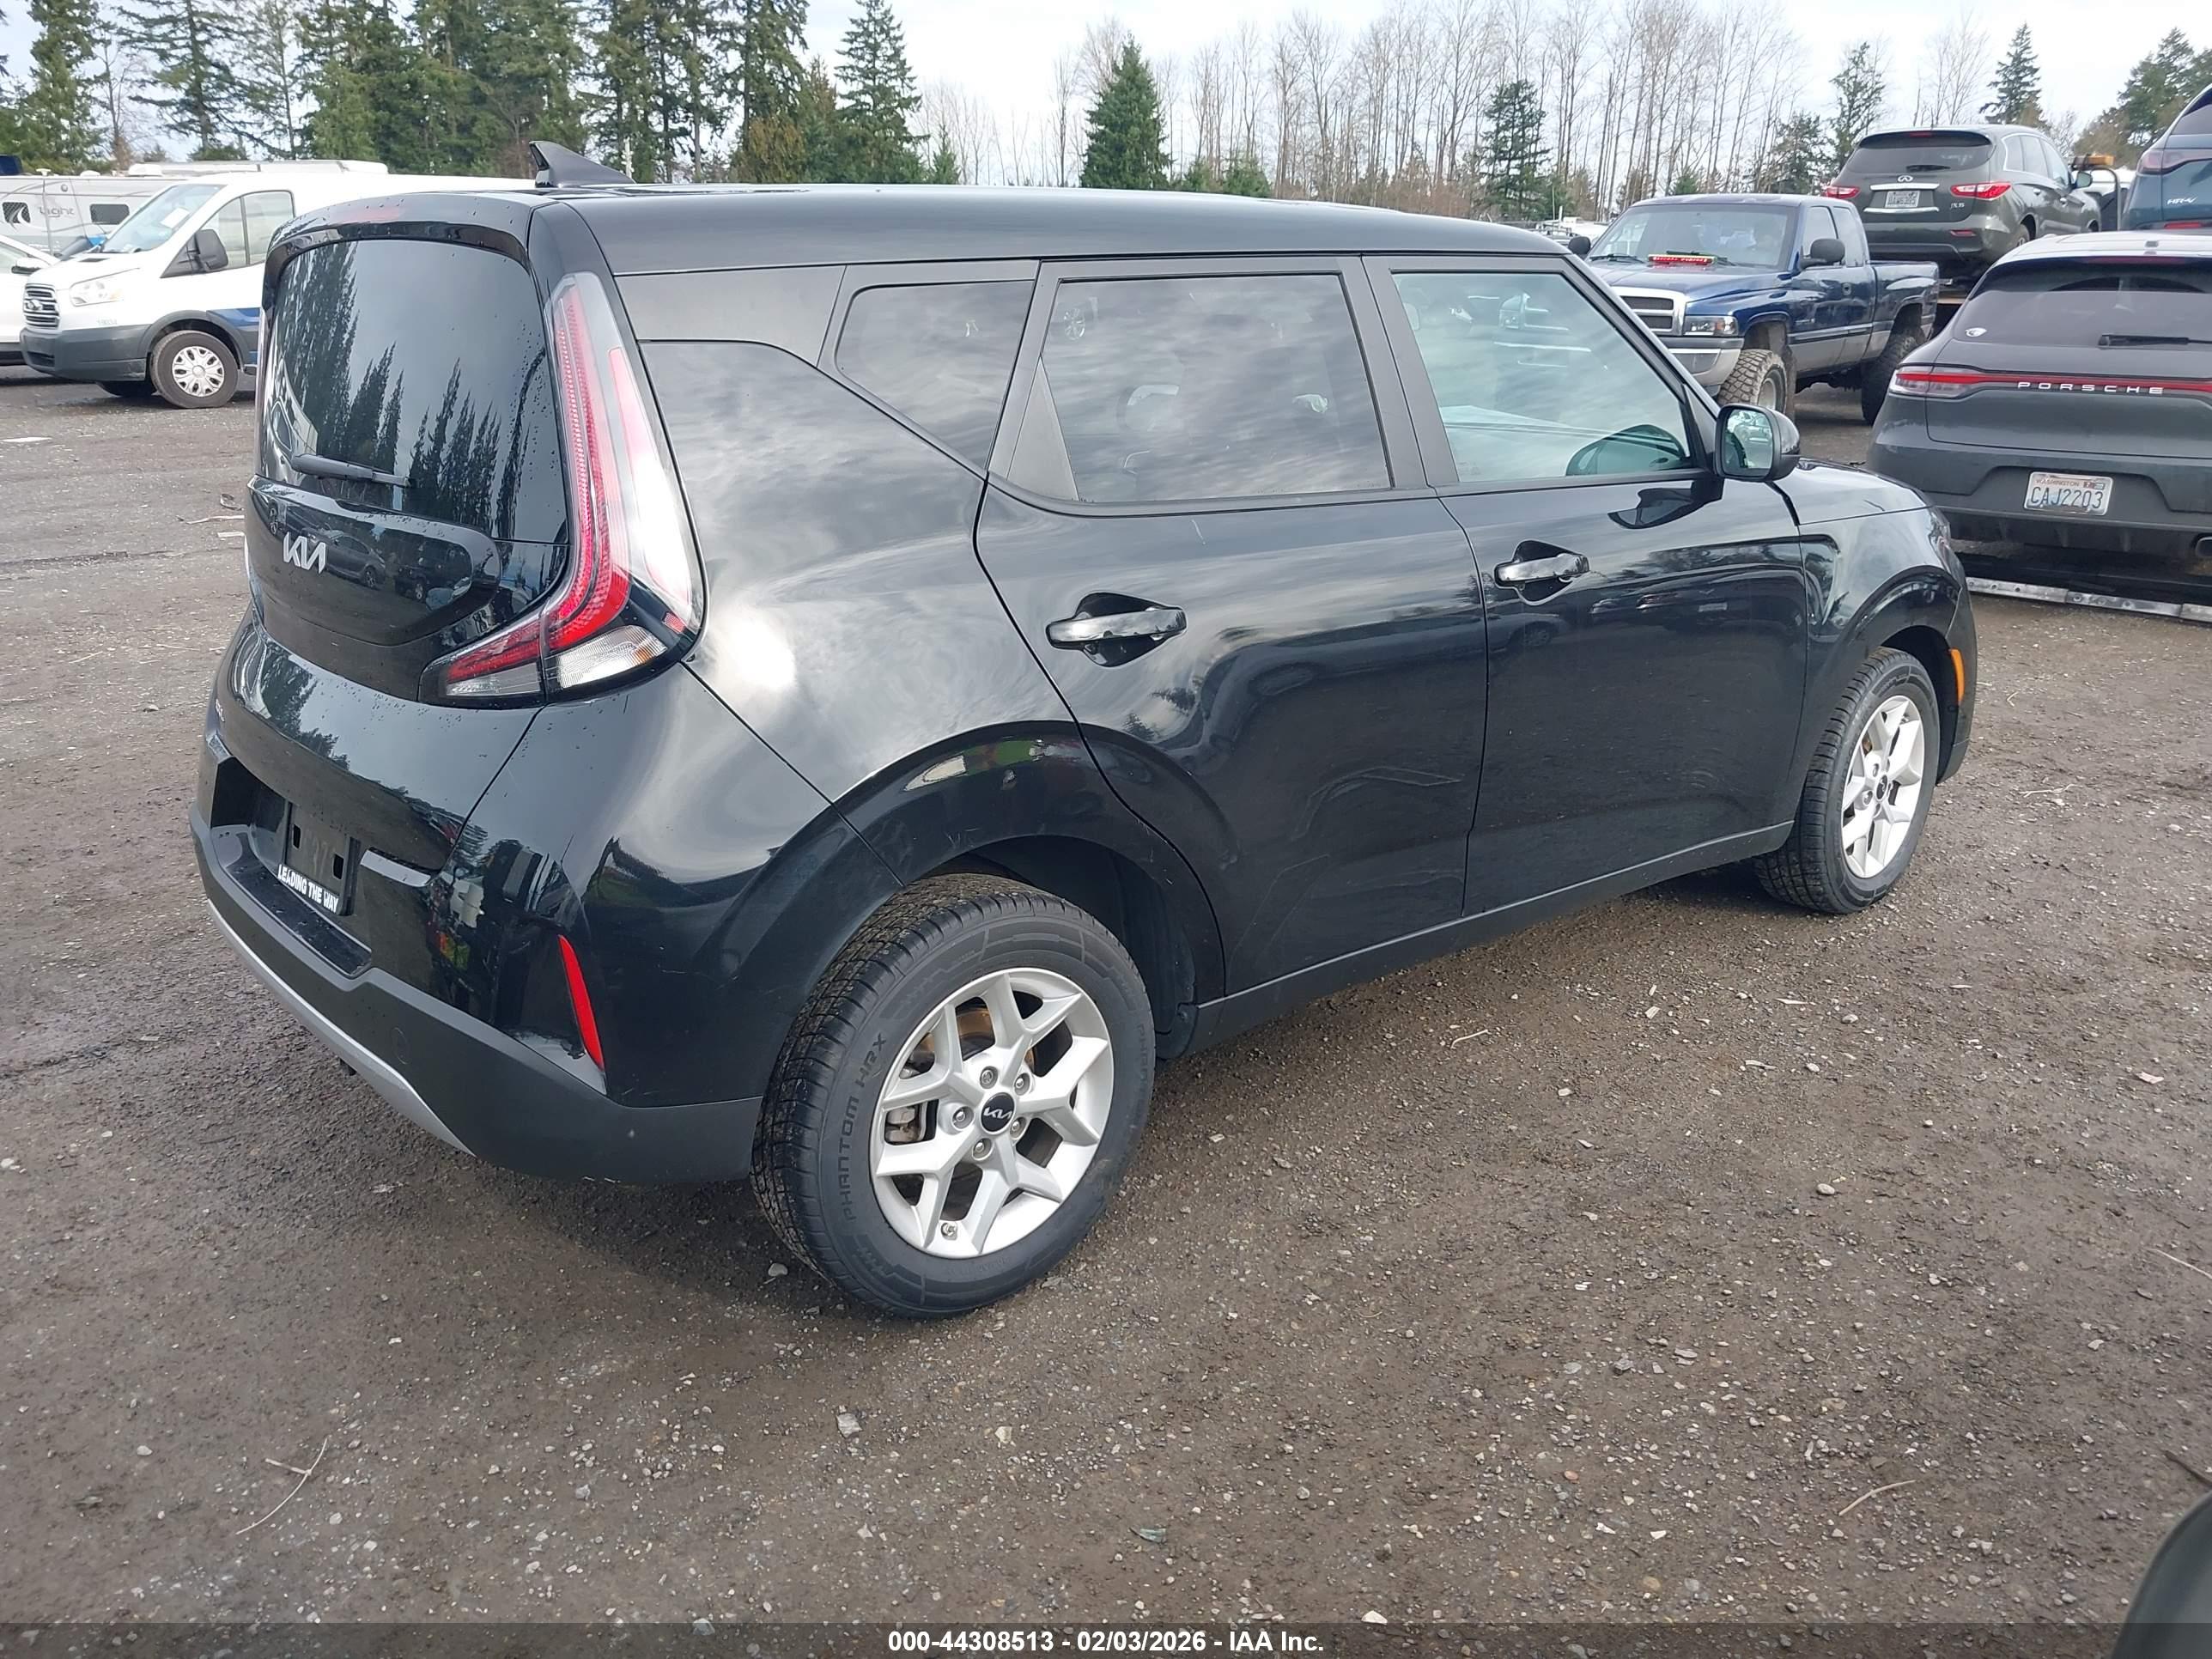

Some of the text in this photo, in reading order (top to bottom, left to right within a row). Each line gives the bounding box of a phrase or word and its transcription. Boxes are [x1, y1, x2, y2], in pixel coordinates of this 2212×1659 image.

[2018, 381, 2164, 394] PORSCHE
[2031, 486, 2104, 508] CAJ2203
[283, 532, 325, 574] KIA
[277, 864, 339, 913] LEADING THE WAY
[838, 1033, 887, 1222] PHANTOM HRX
